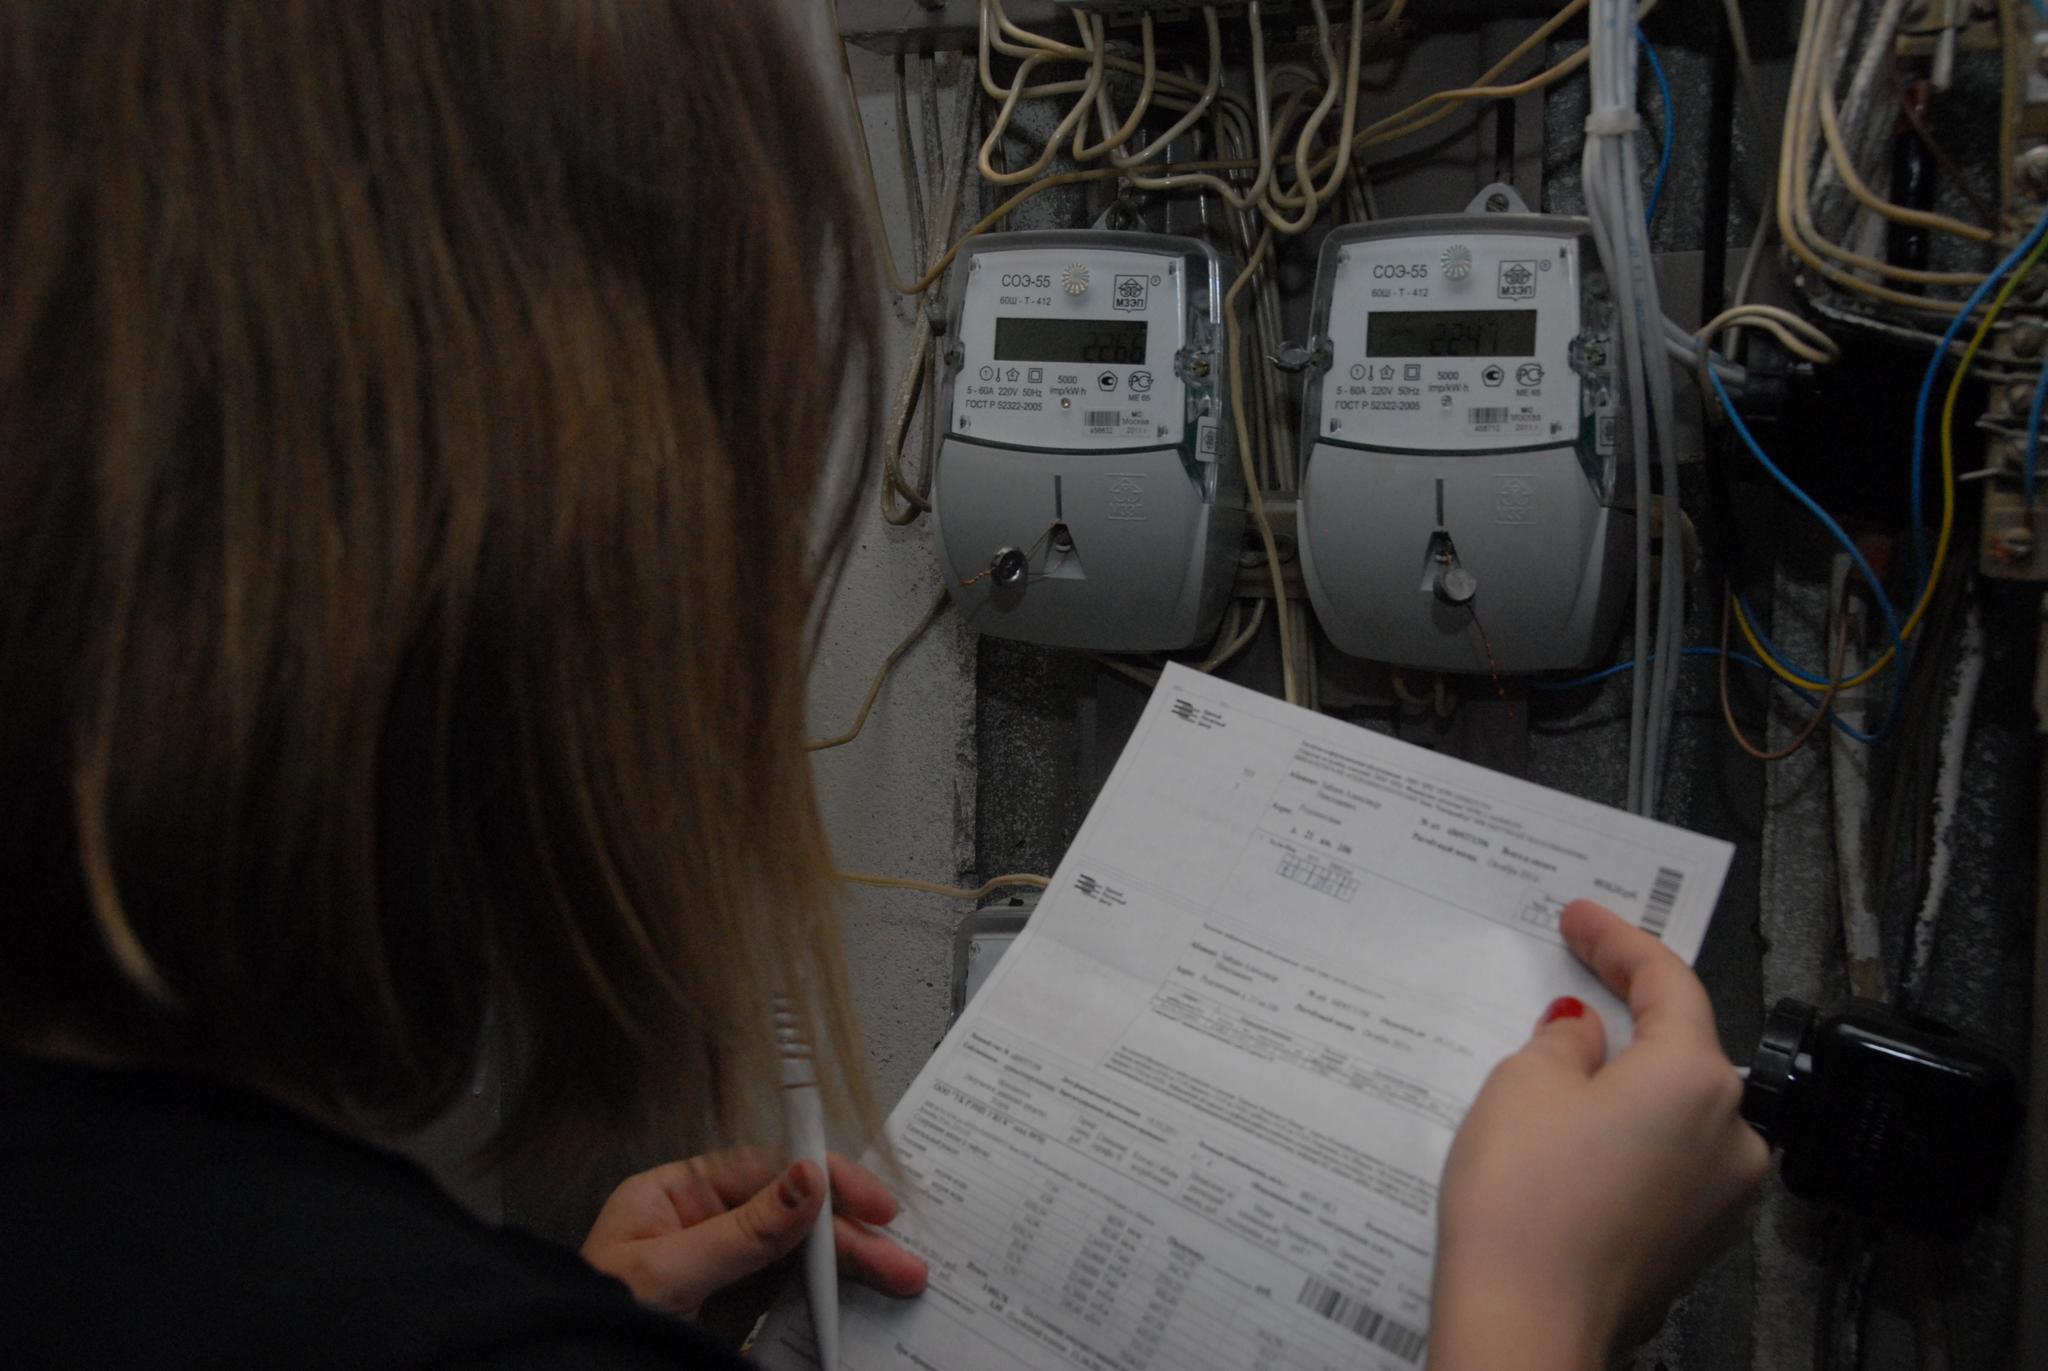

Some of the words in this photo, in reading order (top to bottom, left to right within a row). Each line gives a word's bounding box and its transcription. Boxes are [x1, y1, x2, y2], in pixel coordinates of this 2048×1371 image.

[1373, 265, 1428, 279] СОЭ-55
[1001, 274, 1051, 288] СОЭ-55
[1412, 288, 1429, 297] 412
[1036, 297, 1052, 306] 412
[1057, 375, 1078, 384] 5000
[1437, 371, 1459, 381] 5000
[967, 386, 973, 395] 5
[998, 387, 1019, 396] 220V
[1022, 388, 1042, 397] 50Hz
[1336, 386, 1342, 395] 5
[1371, 386, 1393, 395] 220V
[1397, 386, 1420, 396] 50Hz
[965, 400, 988, 409] ГОСТ
[997, 401, 1043, 411] 52322-2005
[1334, 400, 1360, 409] ГОСТ
[1370, 401, 1421, 410] 52322-2005
